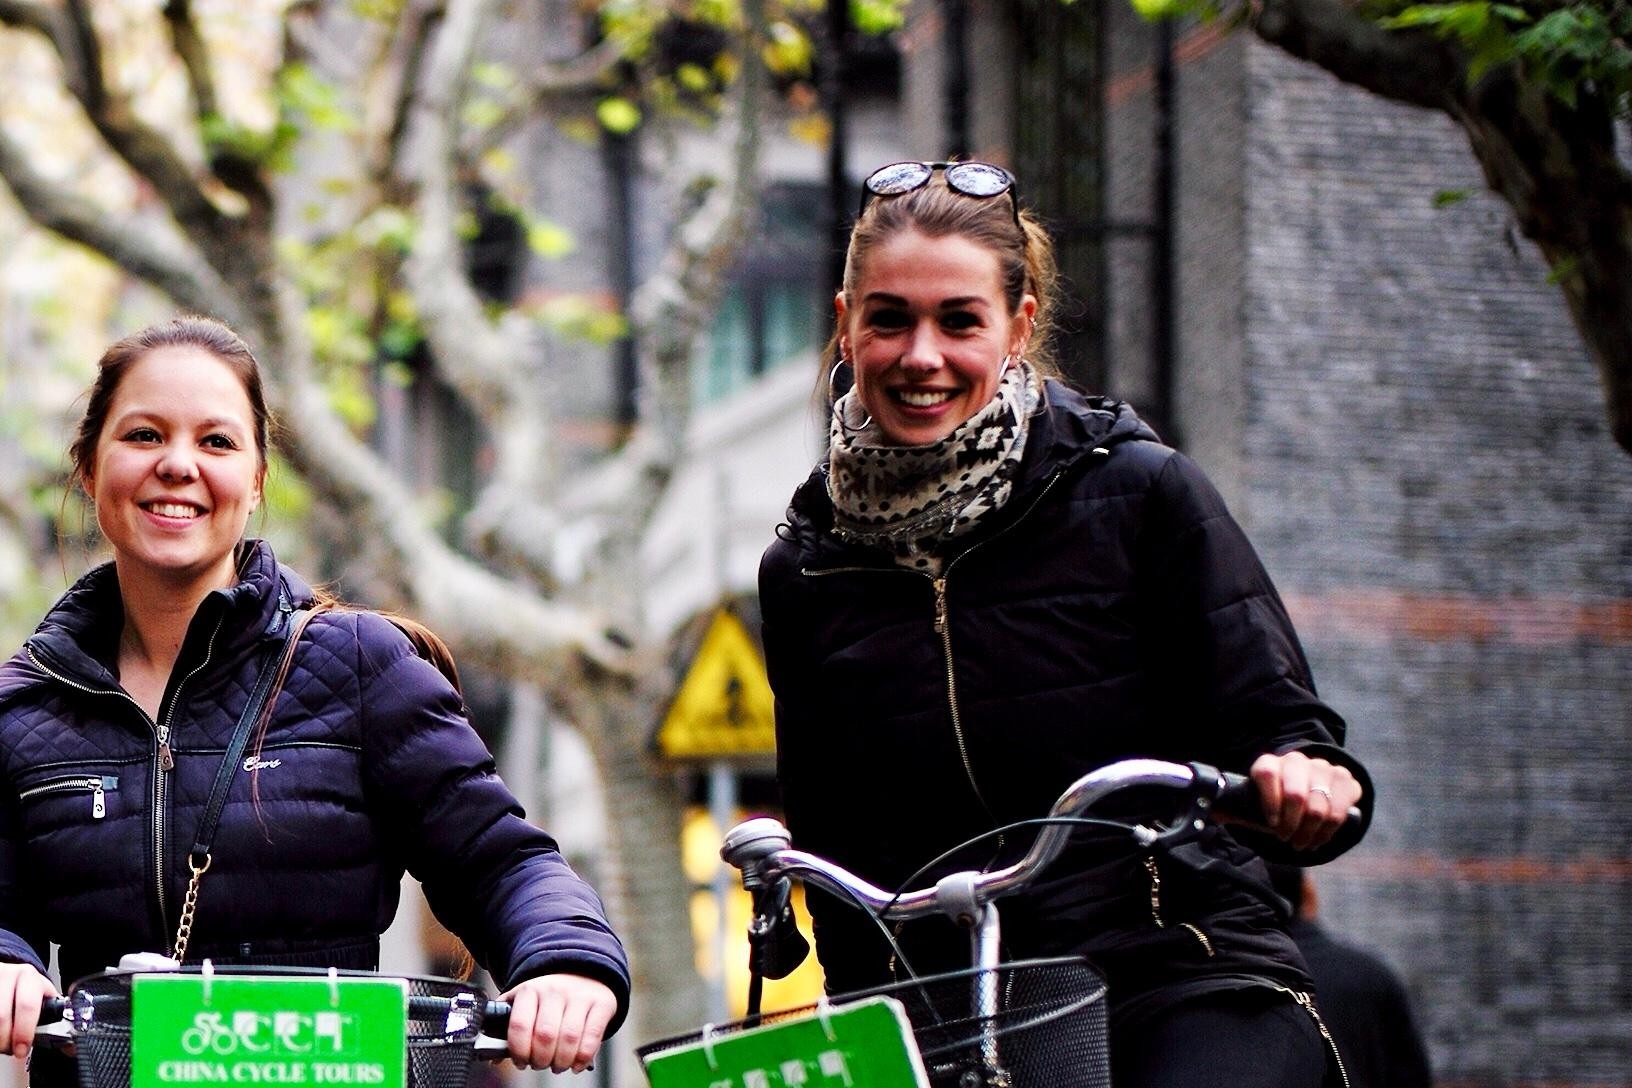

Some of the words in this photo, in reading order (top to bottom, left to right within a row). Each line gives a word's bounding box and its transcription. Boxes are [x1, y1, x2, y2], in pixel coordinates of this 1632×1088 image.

[158, 1061, 229, 1082] CHINA
[232, 1061, 307, 1083] CYCLE
[311, 1062, 385, 1083] TOURS
